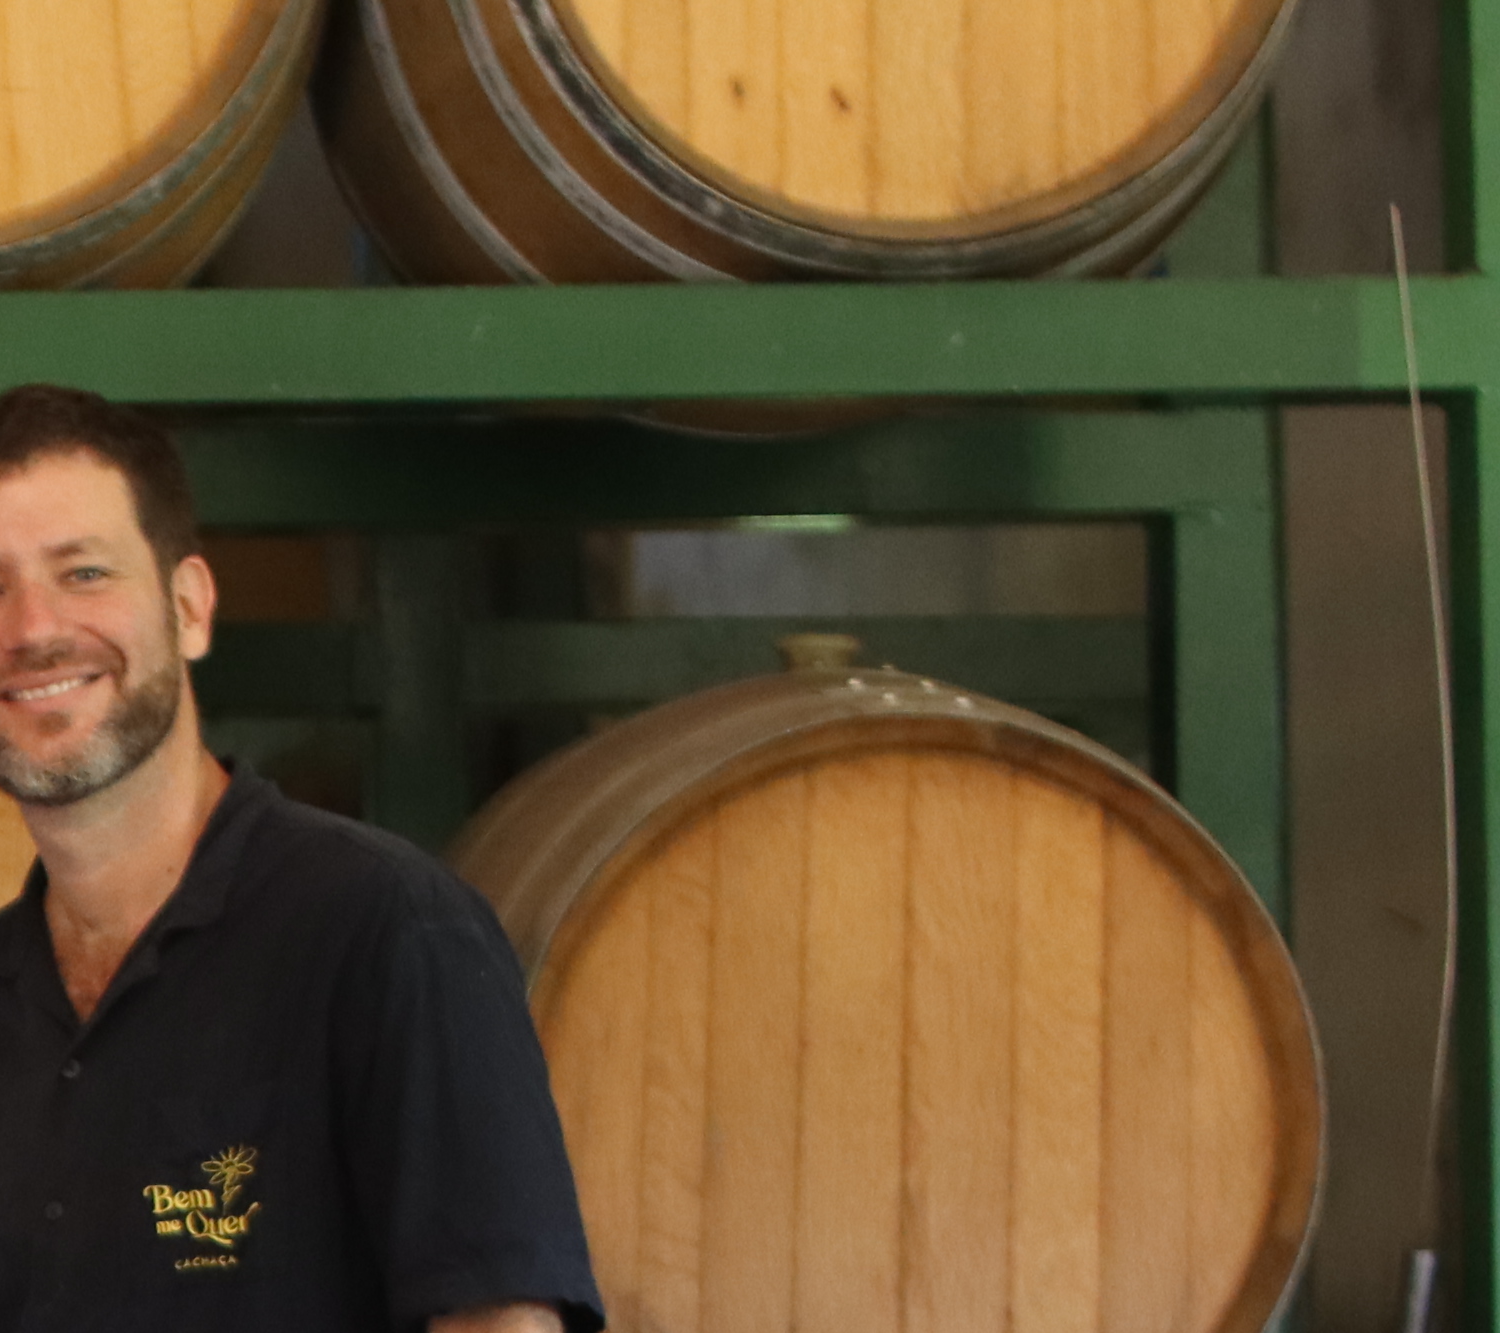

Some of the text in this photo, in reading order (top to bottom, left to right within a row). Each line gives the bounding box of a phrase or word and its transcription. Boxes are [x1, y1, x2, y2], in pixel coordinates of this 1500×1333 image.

[143, 1184, 215, 1215] Bem
[156, 1201, 261, 1247] me Quer
